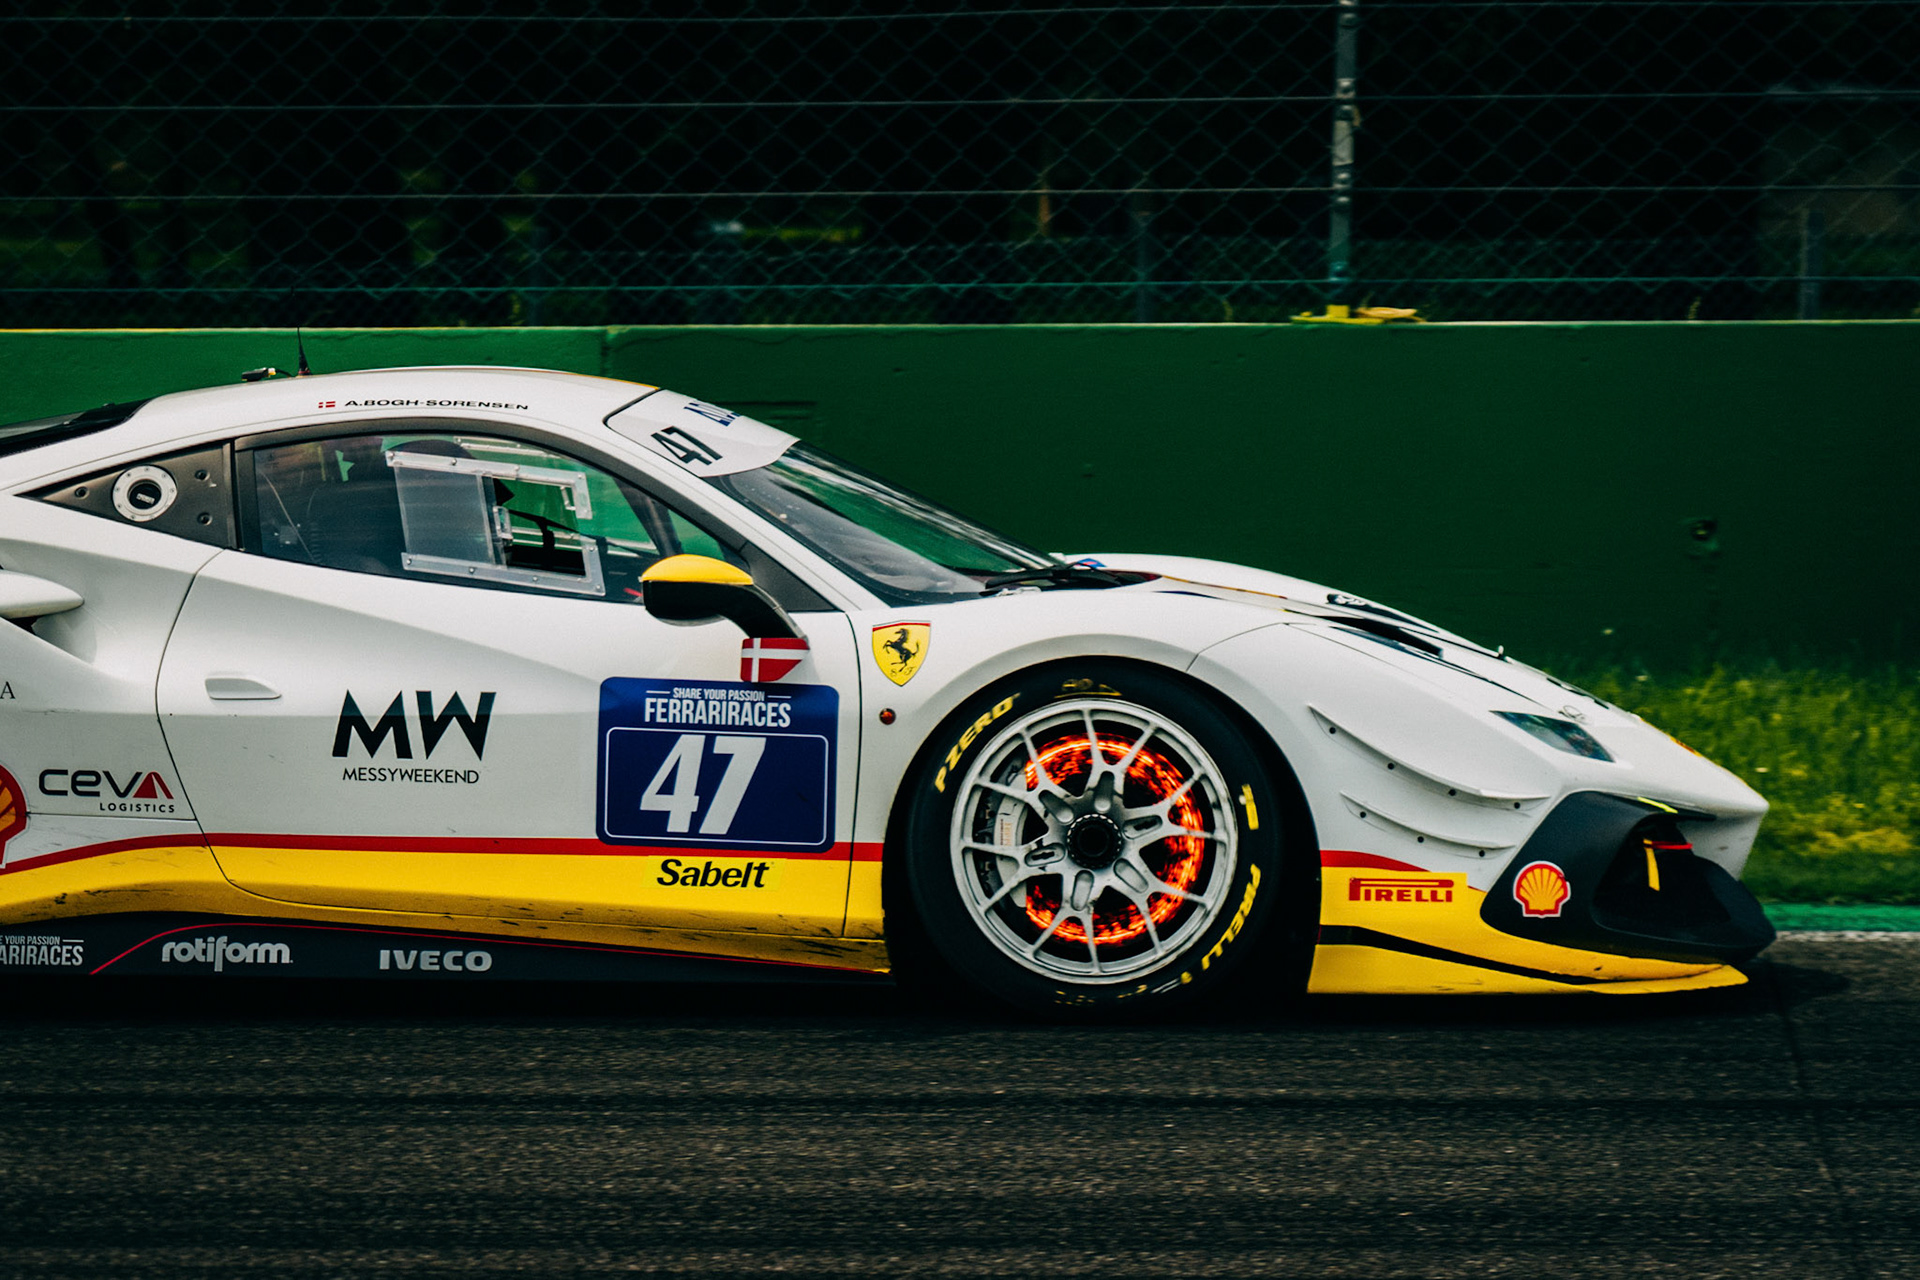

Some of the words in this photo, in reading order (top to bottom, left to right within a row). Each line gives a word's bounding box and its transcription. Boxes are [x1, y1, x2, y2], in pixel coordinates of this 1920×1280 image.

[650, 425, 723, 466] 47
[672, 687, 702, 700] SHARE
[704, 688, 727, 701] YOUR
[727, 690, 766, 702] PASSION
[332, 689, 497, 762] MW
[644, 697, 792, 728] FERRARIRACES
[342, 767, 480, 784] MESSYWEEKEND
[639, 733, 767, 835] 47
[99, 802, 175, 813] LOGISTICS
[656, 858, 770, 888] Sabelt
[1349, 877, 1454, 903] PIRELLI
[5, 935, 26, 945] YOUR
[27, 936, 61, 945] PASSION
[379, 949, 493, 972] IVECO
